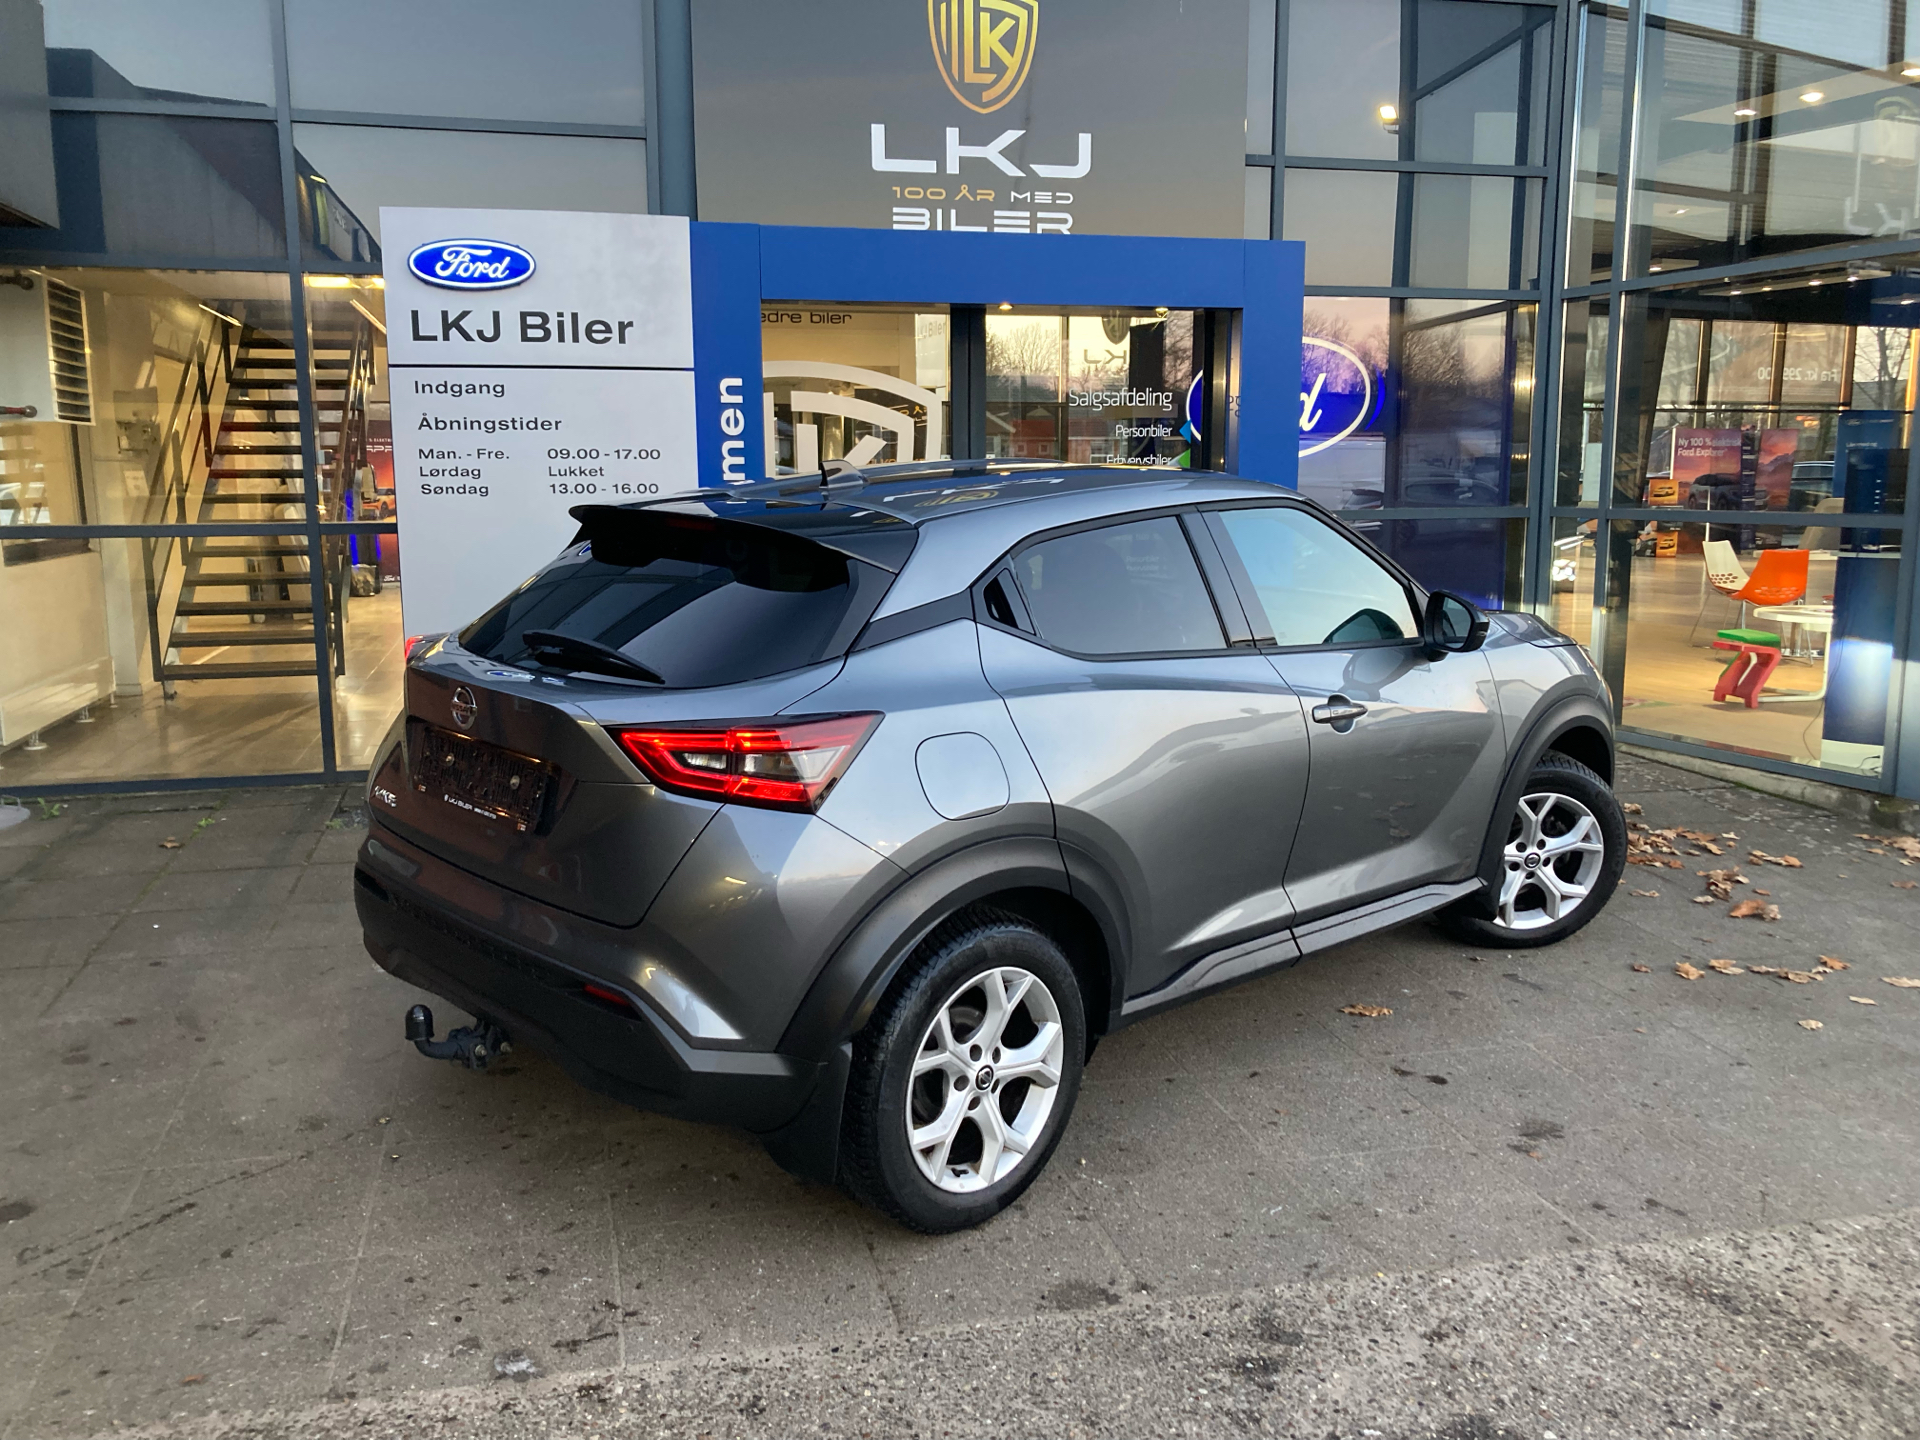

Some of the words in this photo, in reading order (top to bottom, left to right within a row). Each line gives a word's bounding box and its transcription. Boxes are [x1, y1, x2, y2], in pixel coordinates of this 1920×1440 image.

[870, 123, 1092, 179] LKJ
[892, 186, 947, 200] 100
[954, 184, 996, 202] ÅR
[1010, 190, 1074, 205] MED
[892, 206, 1073, 235] BILER
[435, 245, 510, 280] Ford
[410, 309, 500, 343] LKJ
[519, 310, 634, 345] Biler
[809, 311, 852, 325] biler
[414, 380, 506, 398] Indgang
[1068, 387, 1173, 411] Salgsafdeling
[418, 412, 562, 433] Åbningstider
[1115, 424, 1173, 438] Personbiler
[418, 448, 462, 460] Man.
[476, 448, 510, 460] Fre.
[547, 448, 600, 460] 09.00
[613, 448, 661, 460] 17.00
[419, 466, 481, 480] Lørdag
[548, 465, 605, 477] Lukket
[420, 483, 489, 498] Søndag
[549, 483, 597, 495] 13.00
[612, 483, 659, 495] 16.00
